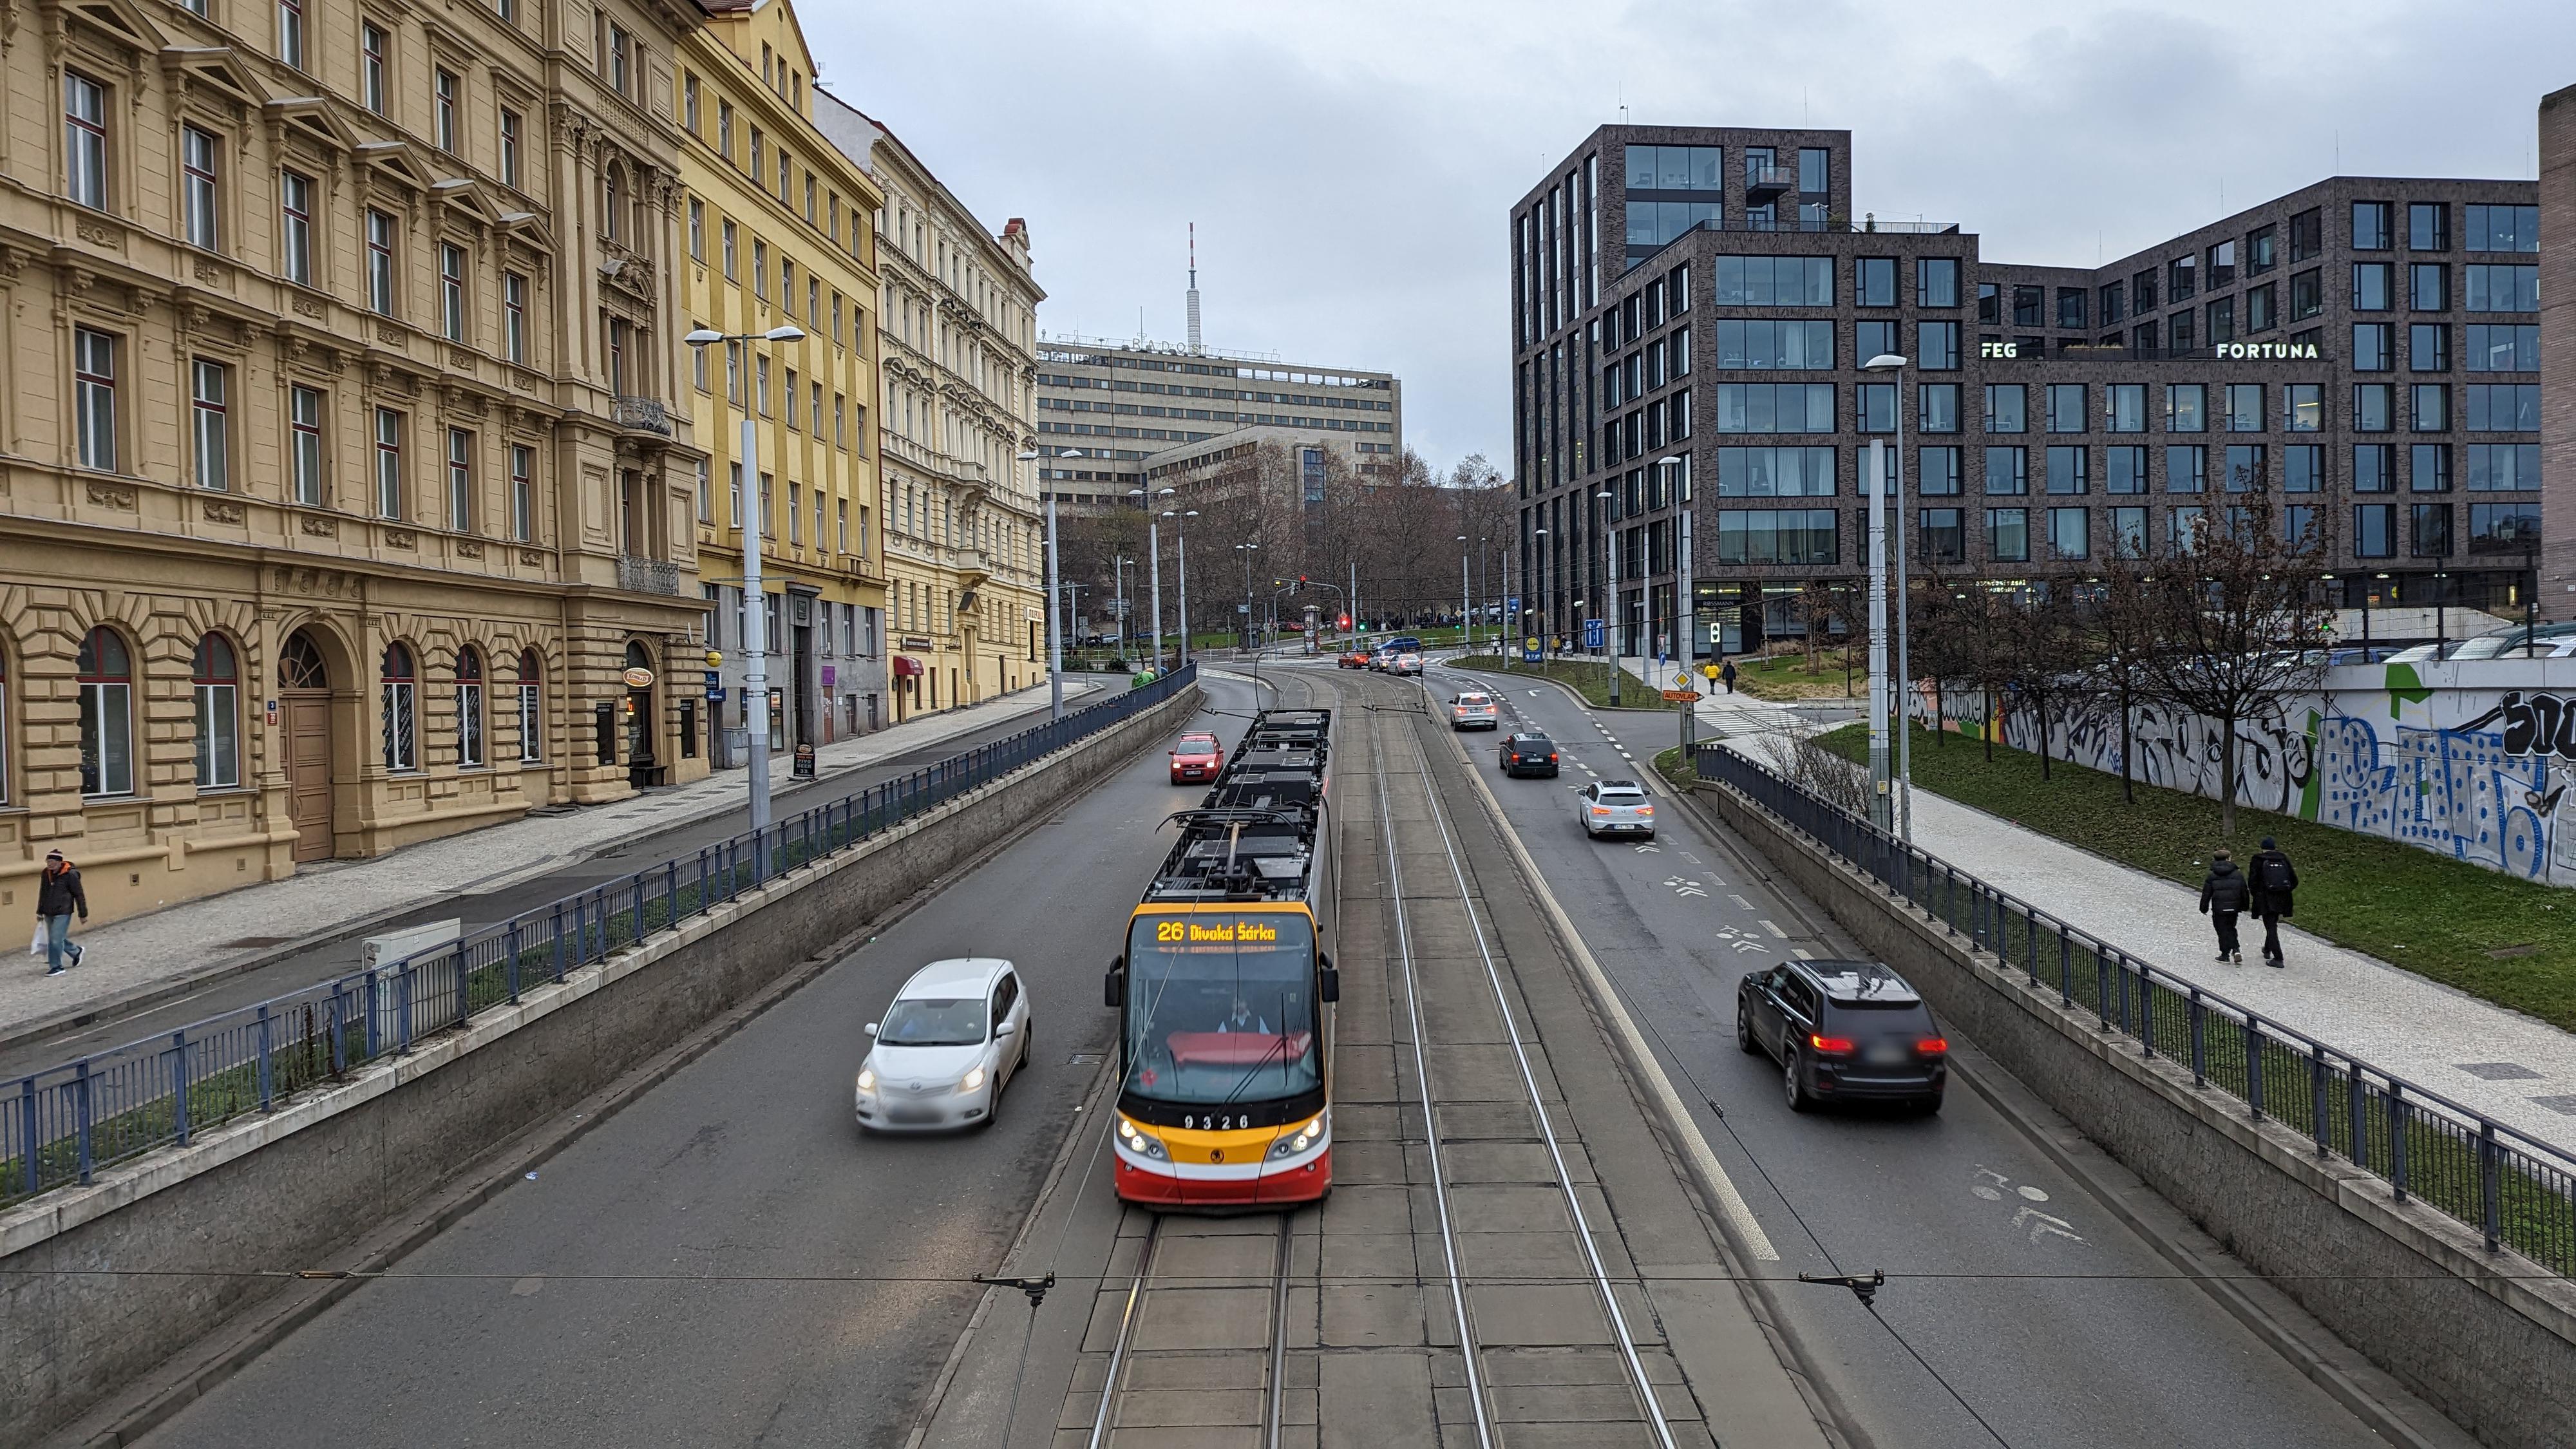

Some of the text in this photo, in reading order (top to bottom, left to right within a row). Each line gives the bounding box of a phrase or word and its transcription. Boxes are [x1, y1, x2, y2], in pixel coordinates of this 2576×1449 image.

[1133, 337, 1209, 355] RADOST
[1982, 343, 2016, 358] FEG
[2217, 343, 2318, 359] FORTUNA
[1158, 922, 1276, 941] 26 Divoká Šárka
[1185, 1115, 1248, 1130] 9326
